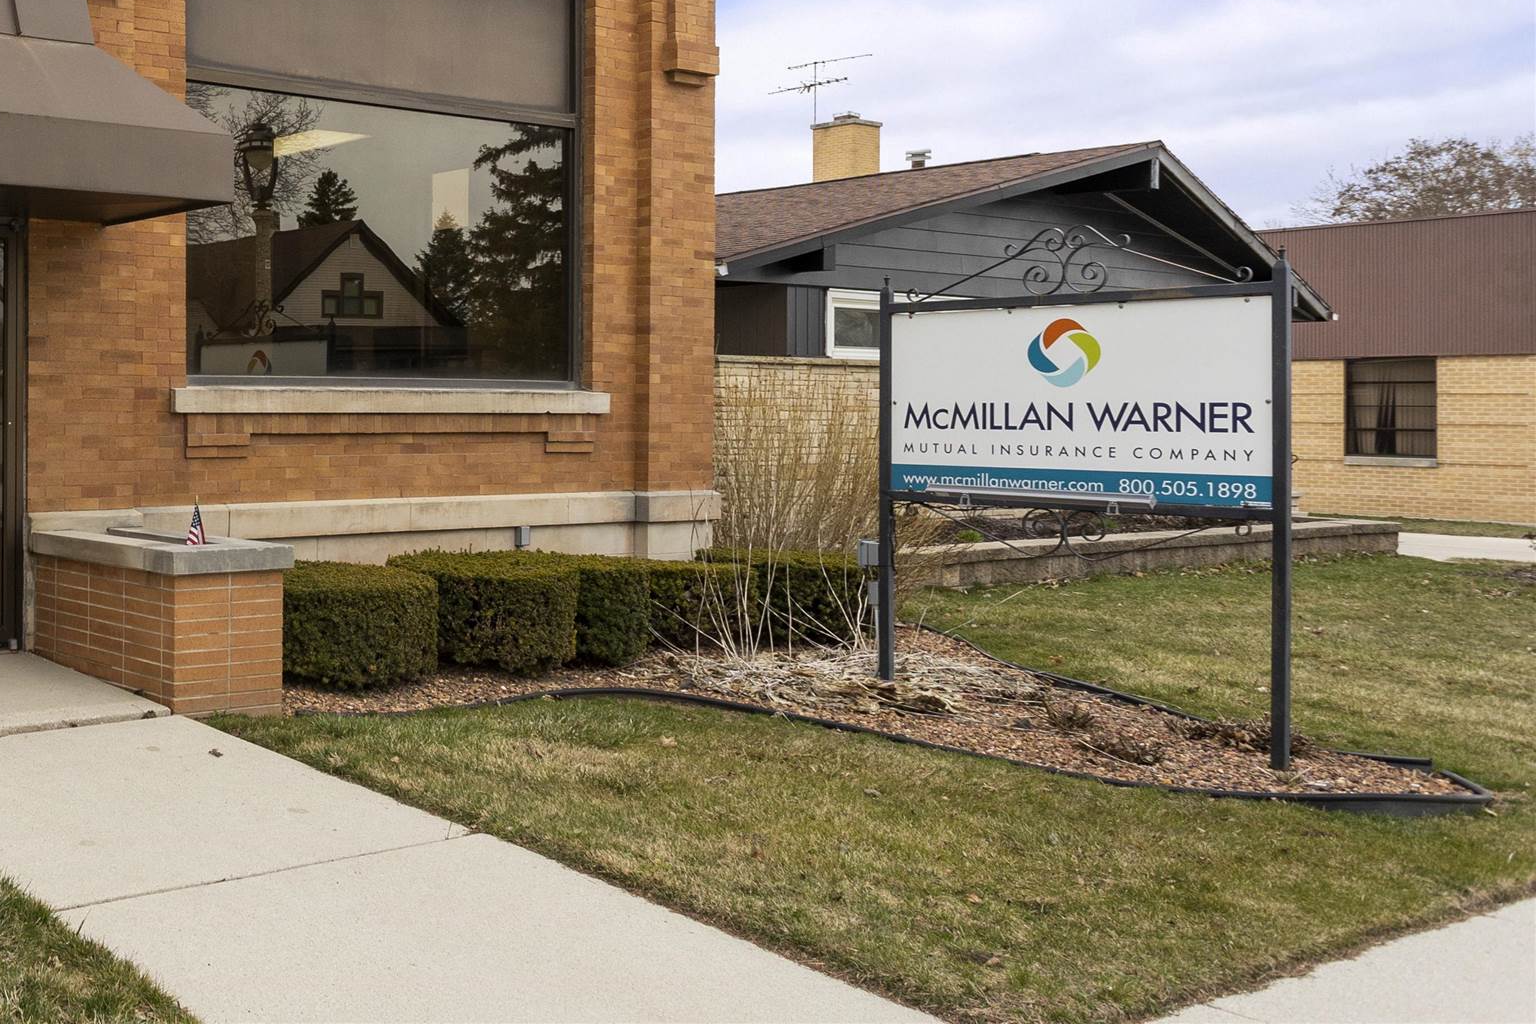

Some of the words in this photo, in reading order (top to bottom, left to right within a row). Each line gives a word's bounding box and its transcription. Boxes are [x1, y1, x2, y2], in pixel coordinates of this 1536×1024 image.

[1085, 401, 1255, 434] WARNER
[903, 442, 978, 455] MUTUAL
[991, 444, 1117, 458] INSURANCE
[1132, 447, 1254, 462] COMPANY
[903, 473, 1104, 493] www.mcmillanwarner.com
[1119, 478, 1257, 499] 800.505.1898
